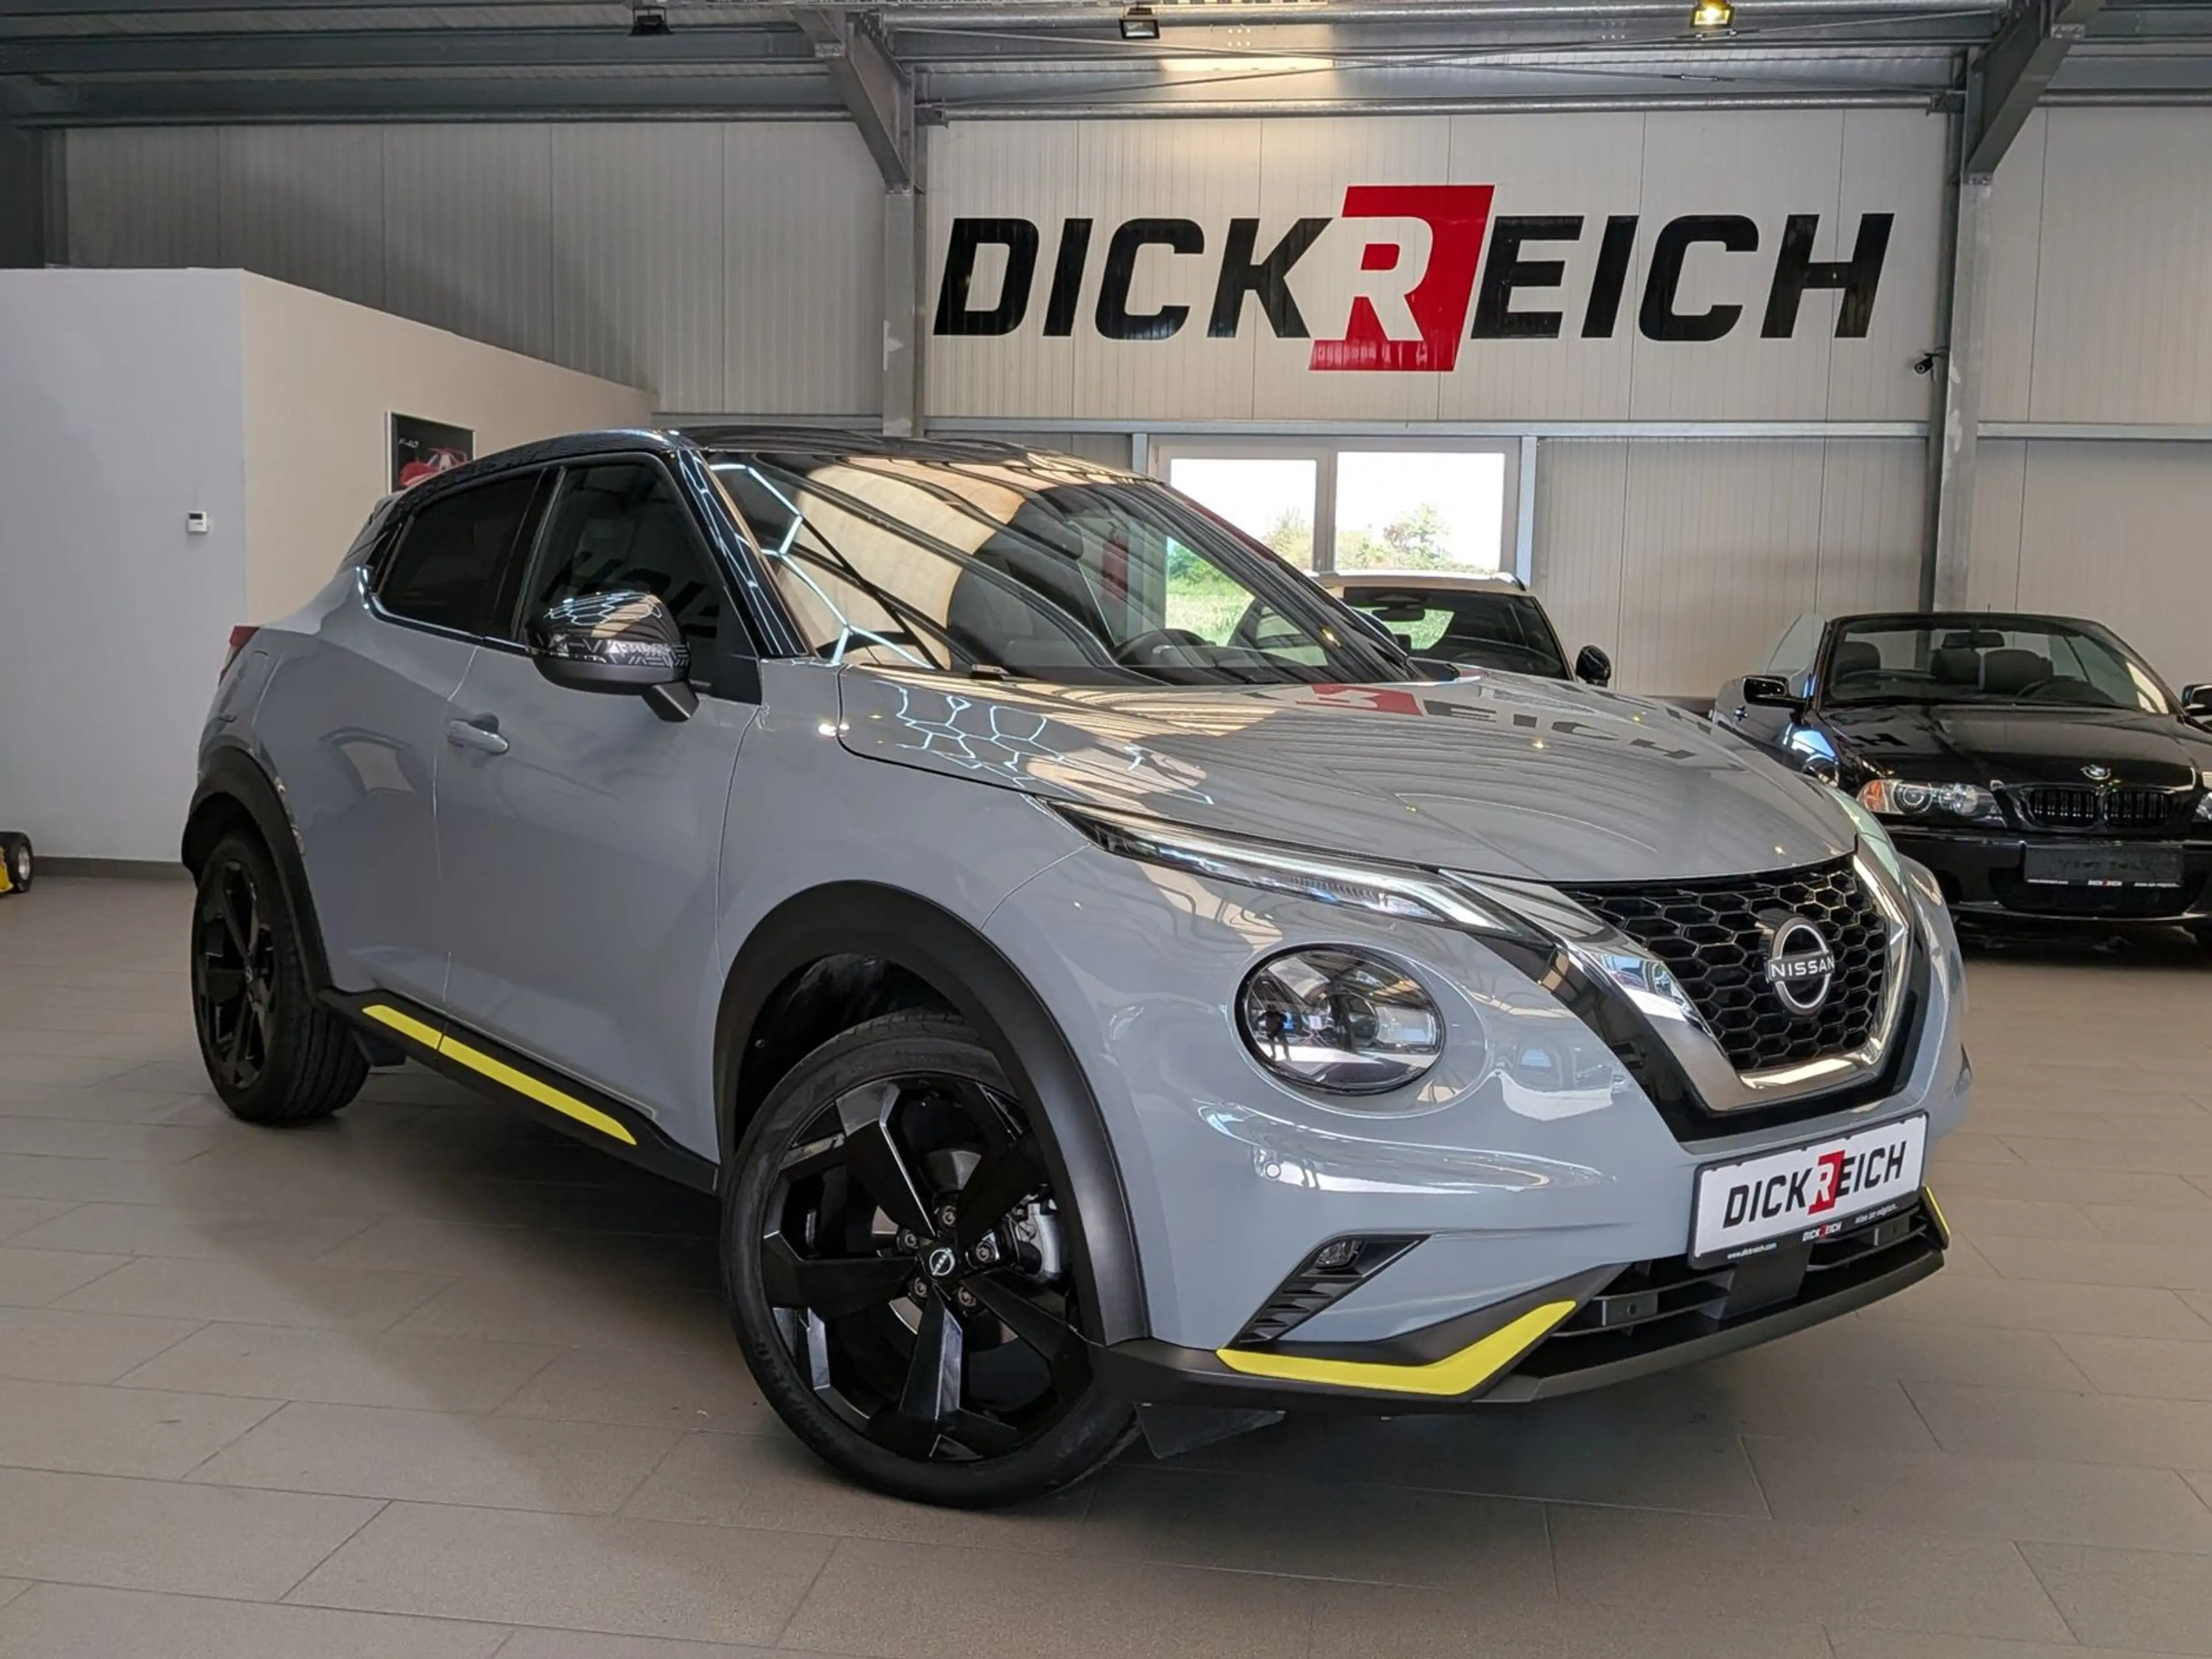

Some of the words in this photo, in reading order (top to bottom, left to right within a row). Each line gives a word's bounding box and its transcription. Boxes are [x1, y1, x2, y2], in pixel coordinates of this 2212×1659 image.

[933, 185, 1895, 372] DICKREICH
[1770, 955, 1835, 978] NISSAN
[1722, 1140, 1906, 1229] DICKREICH
